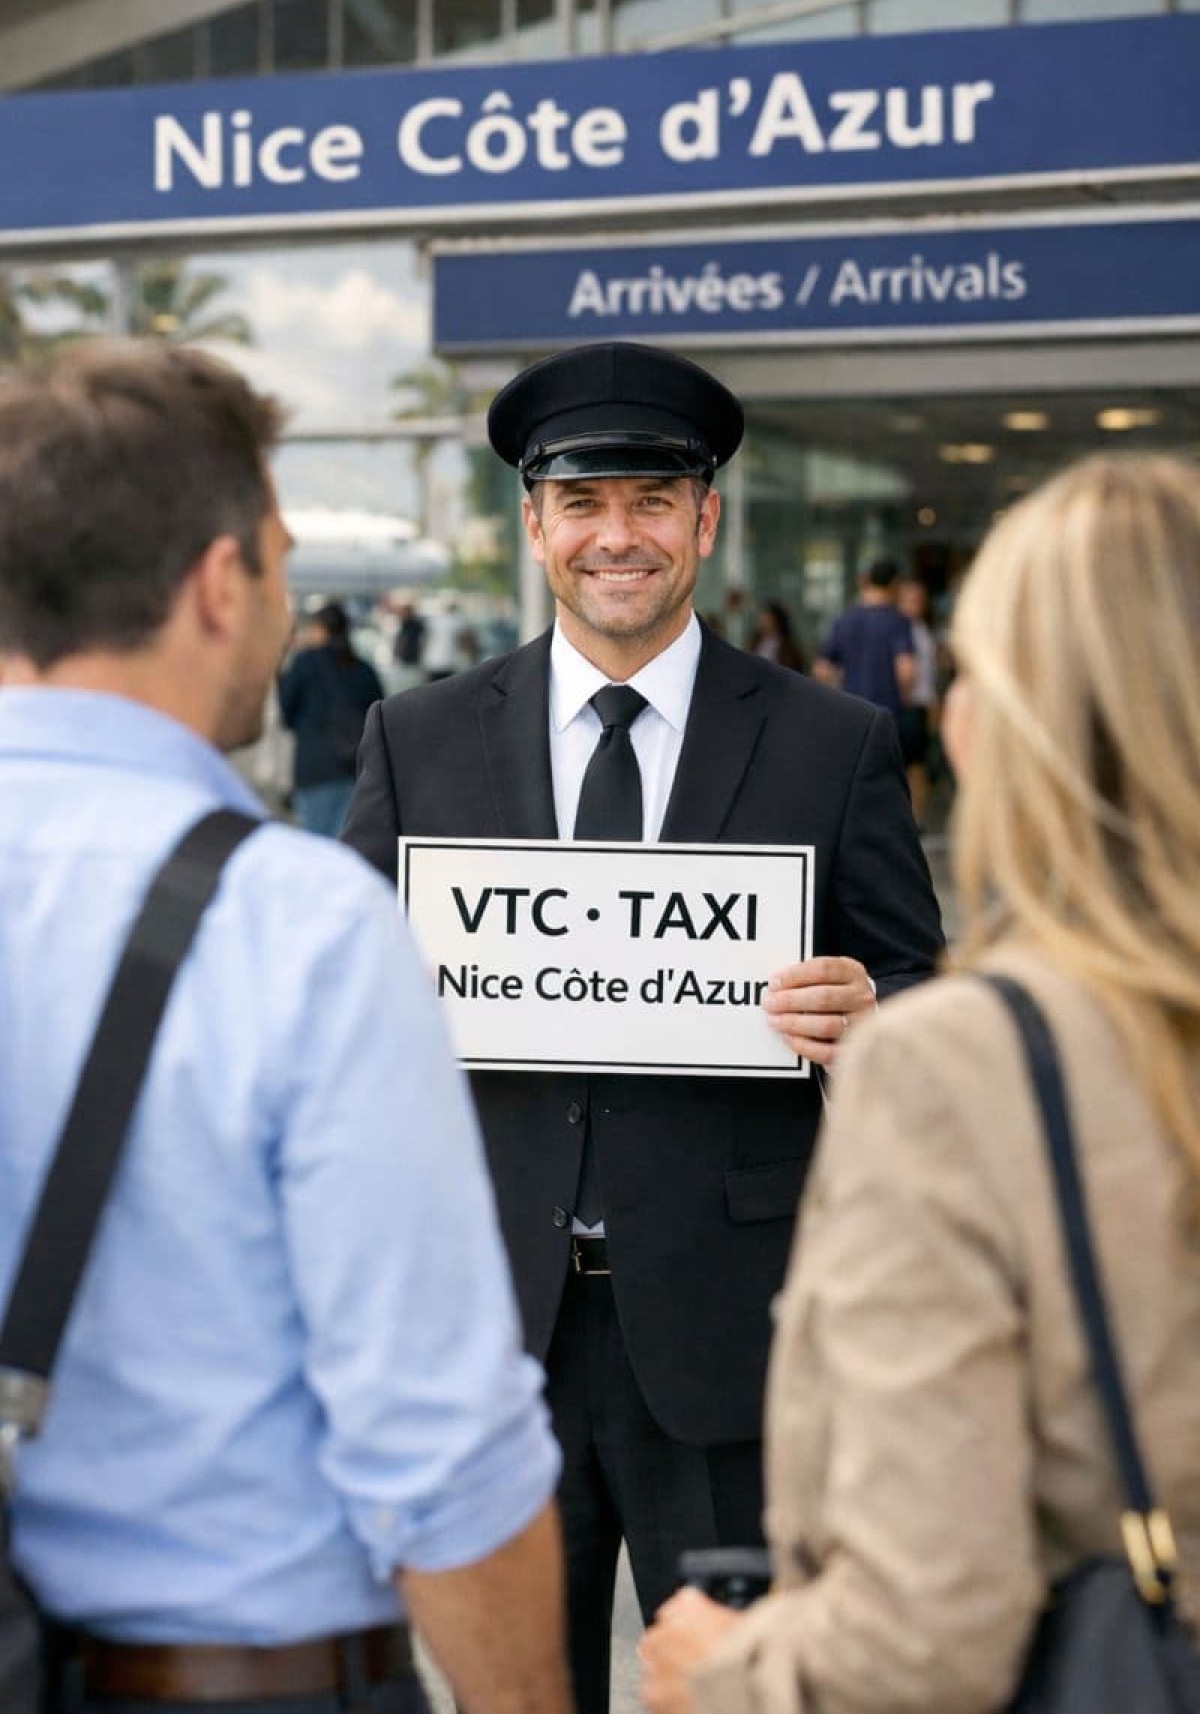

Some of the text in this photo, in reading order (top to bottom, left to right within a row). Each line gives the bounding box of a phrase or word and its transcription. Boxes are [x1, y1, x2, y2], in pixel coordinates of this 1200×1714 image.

[153, 72, 995, 192] Nice Côte d’Azur
[568, 264, 784, 317] Arrivées
[829, 253, 1027, 305] Arrivals
[451, 886, 569, 937] VTC
[618, 890, 757, 941] TAXI
[438, 964, 769, 1006] Nice Côte d'Azur
